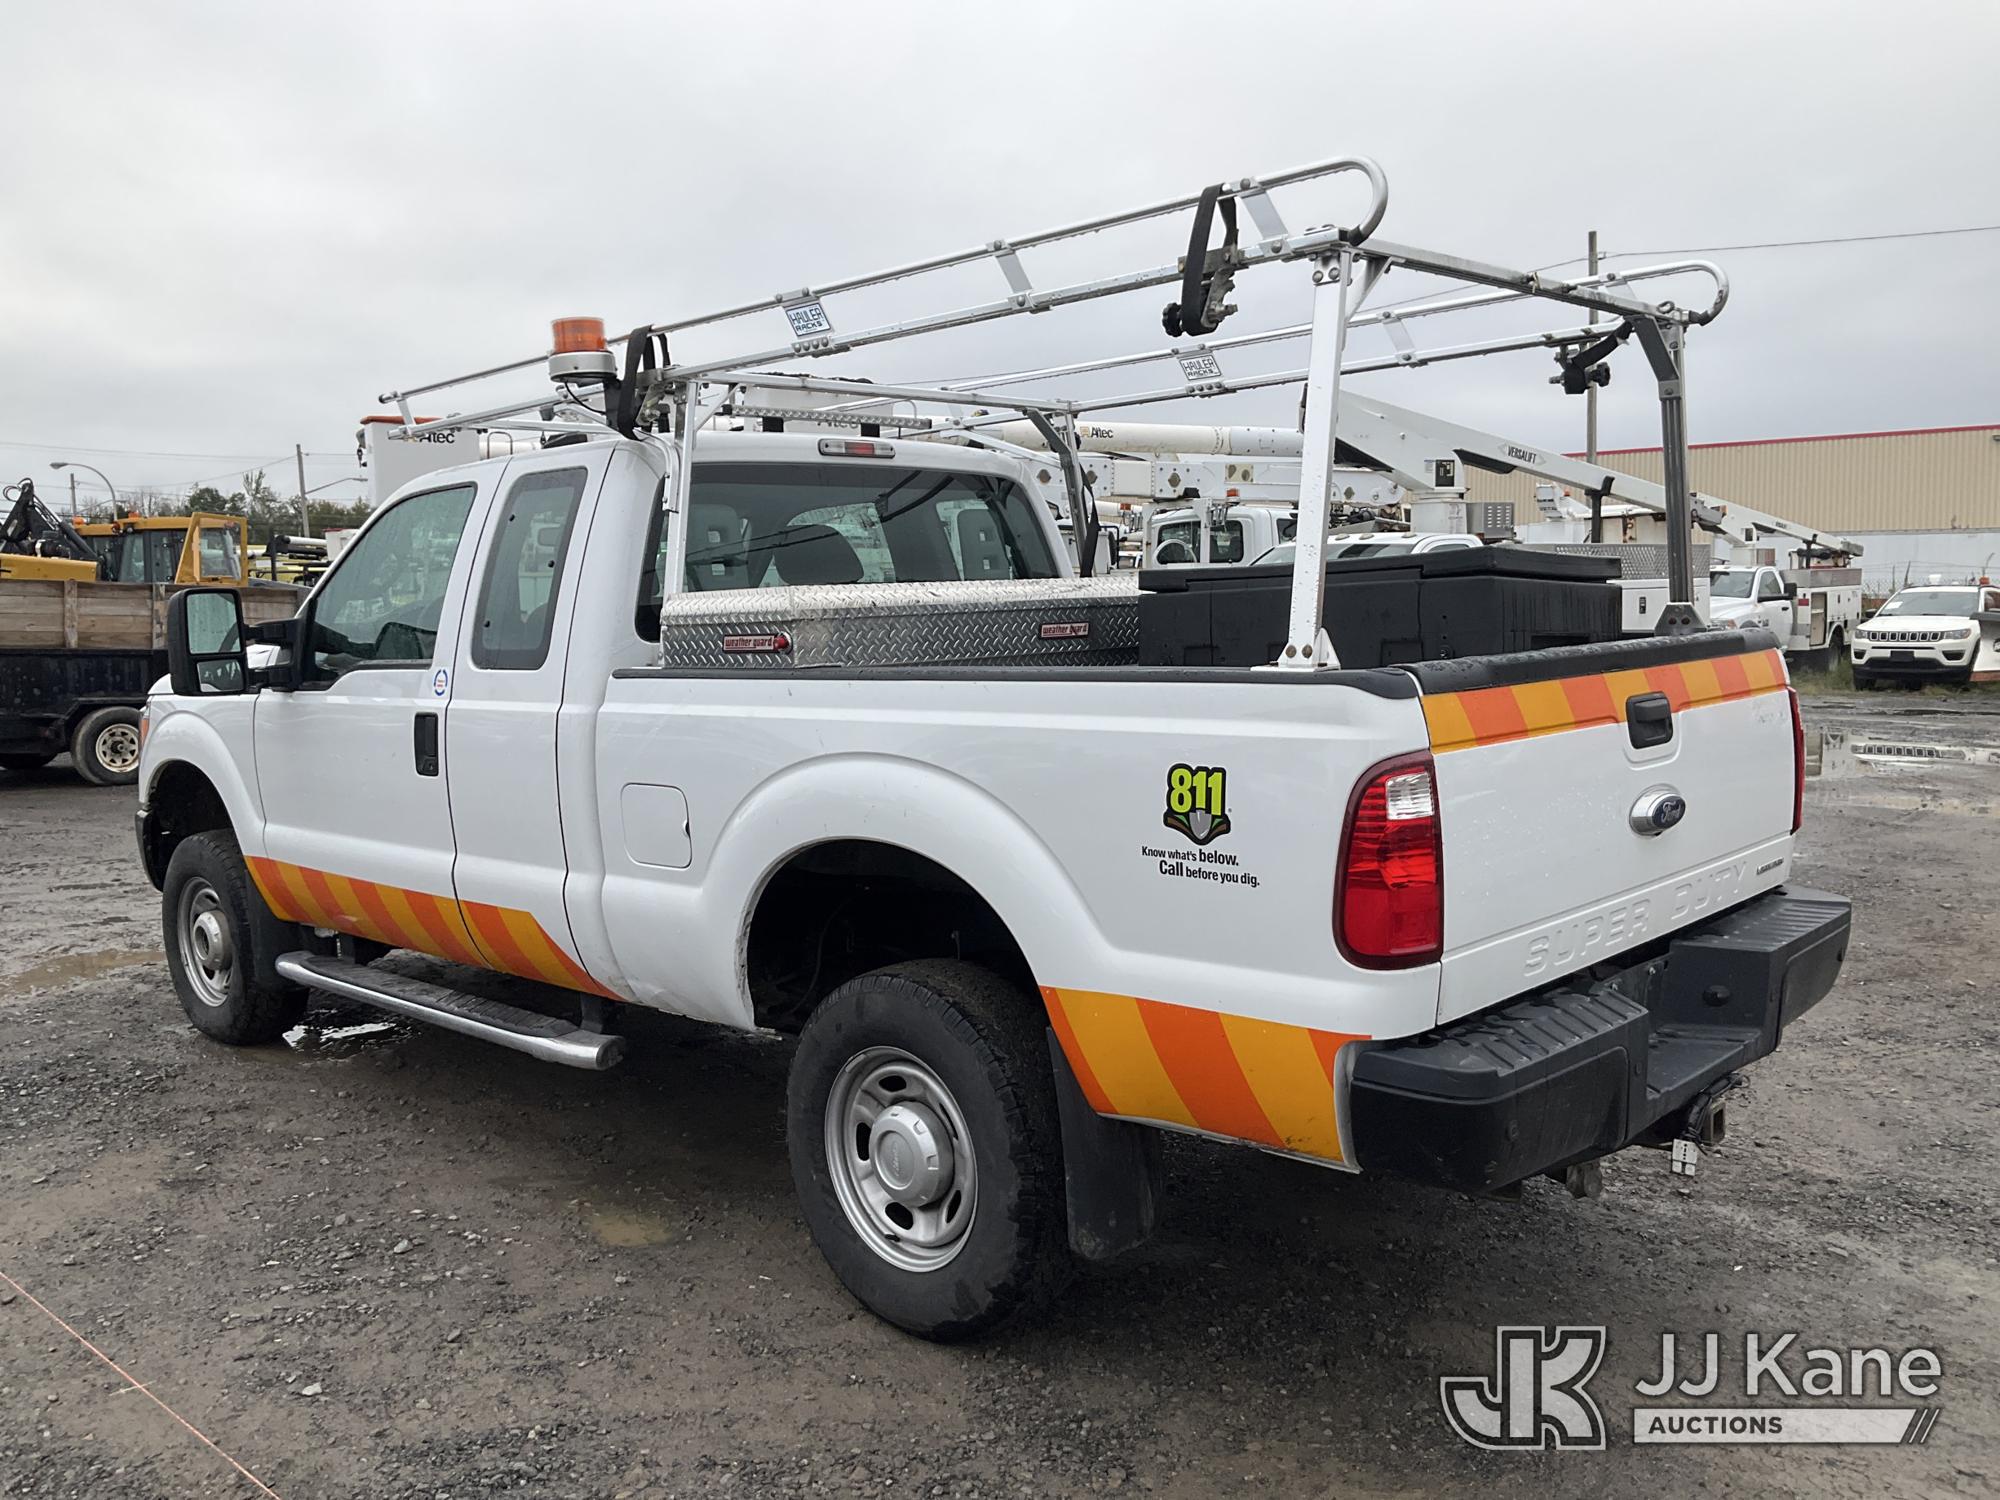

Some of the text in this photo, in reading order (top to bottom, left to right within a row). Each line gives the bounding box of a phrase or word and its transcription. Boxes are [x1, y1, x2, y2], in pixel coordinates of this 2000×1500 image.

[790, 307, 825, 325] HAULER
[795, 320, 823, 331] RACKS
[1183, 358, 1216, 371] HAULER
[1091, 426, 1114, 439] Altec
[1507, 445, 1537, 464] VERSALIFT
[1043, 625, 1068, 634] weather
[725, 637, 773, 648] weather guard
[1170, 767, 1223, 816] 811
[1661, 800, 1682, 823] Ford
[1141, 846, 1239, 867] Know what's below.
[1159, 859, 1260, 888] Call before you dig.
[1523, 860, 1748, 978] SUPER DUTY
